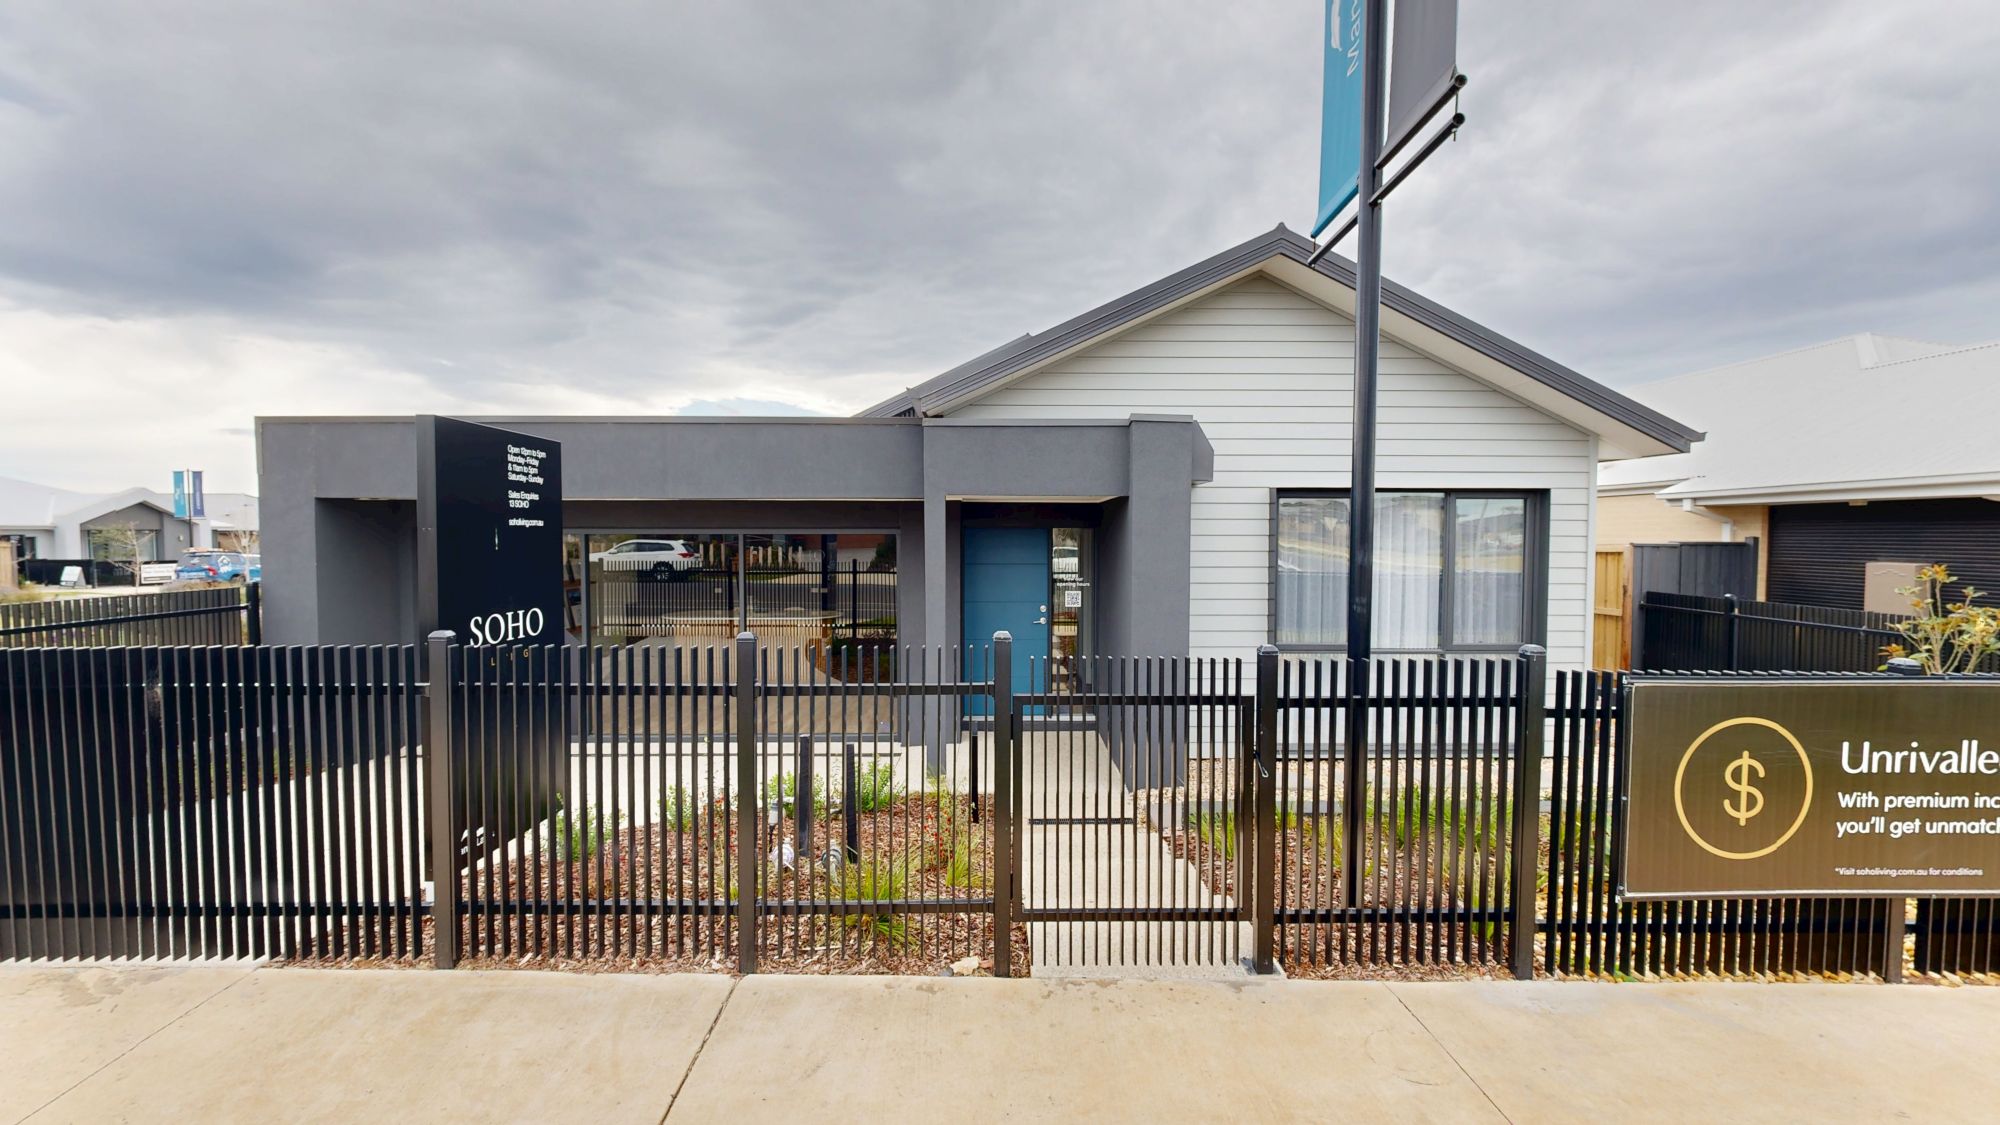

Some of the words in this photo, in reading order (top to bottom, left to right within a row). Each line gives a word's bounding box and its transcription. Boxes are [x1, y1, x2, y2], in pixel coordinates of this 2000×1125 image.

[507, 444, 520, 454] Open
[537, 450, 546, 459] 5pm
[507, 463, 512, 471] &
[528, 466, 538, 475] 5pm
[508, 490, 520, 499] Sales
[520, 491, 540, 501] Enquiries
[509, 500, 514, 508] 13
[514, 500, 529, 509] SOHO
[469, 607, 544, 648] SOHO
[1841, 739, 2000, 774] Unrivalle
[1837, 791, 1879, 808] With
[1884, 792, 1969, 812] premium
[1974, 792, 2000, 809] inc
[1836, 816, 1885, 838] you'll
[1889, 818, 1922, 839] get
[1856, 867, 1928, 877] soholiving.com.au
[1928, 867, 1941, 876] for
[1941, 867, 1984, 876] conditions
